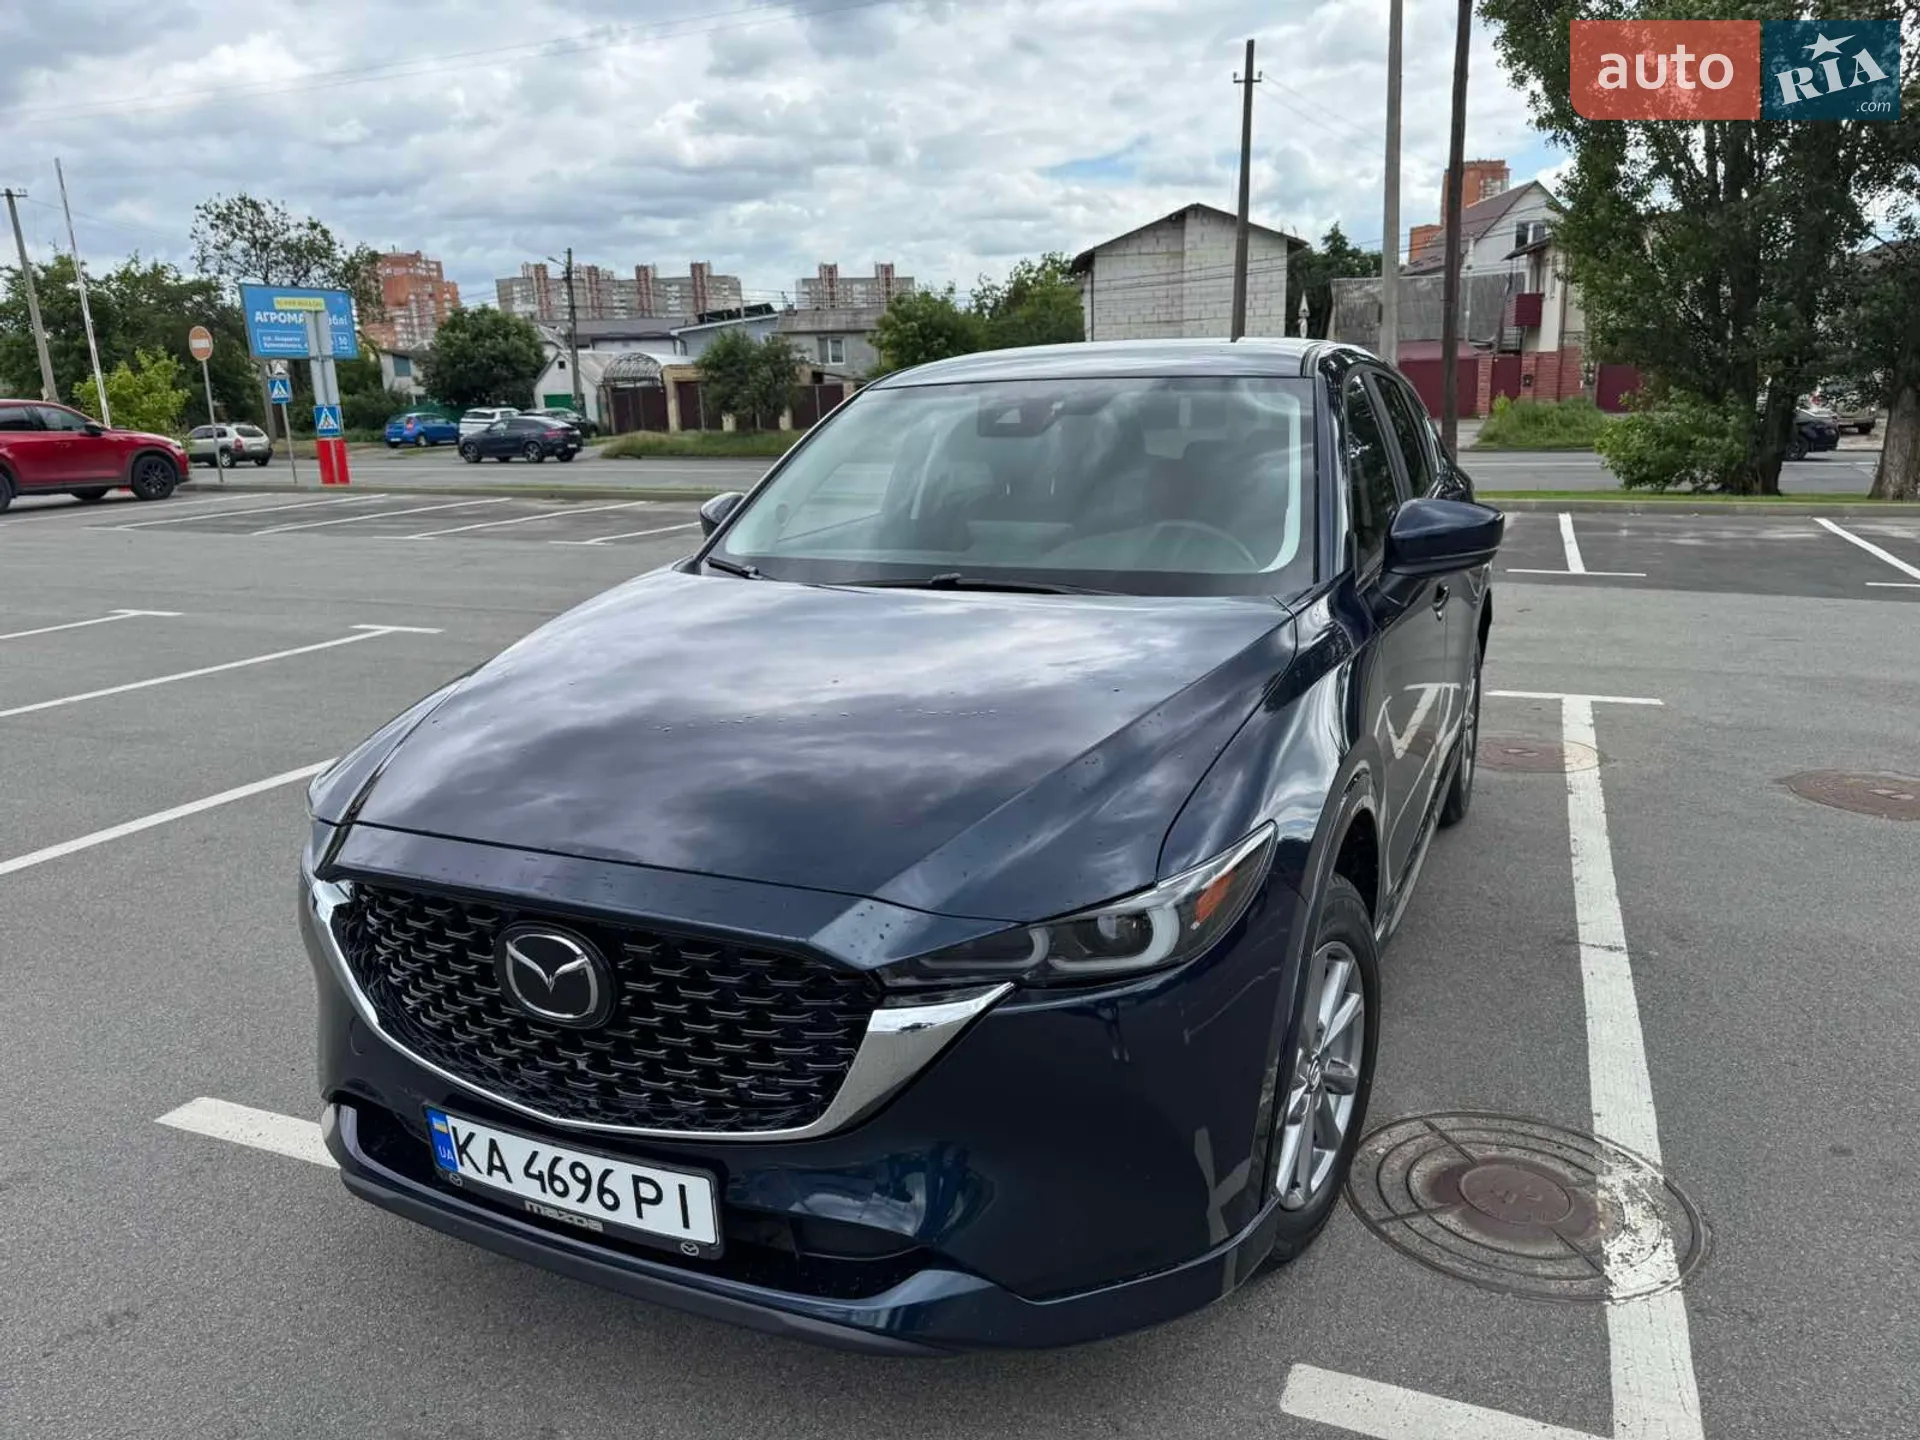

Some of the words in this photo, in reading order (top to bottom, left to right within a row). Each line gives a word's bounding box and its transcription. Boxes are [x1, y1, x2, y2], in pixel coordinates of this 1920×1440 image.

[255, 311, 304, 324] АГРОМА
[438, 1145, 455, 1163] UA
[451, 1125, 513, 1184] KA
[523, 1150, 620, 1212] 4696
[631, 1174, 690, 1230] PI
